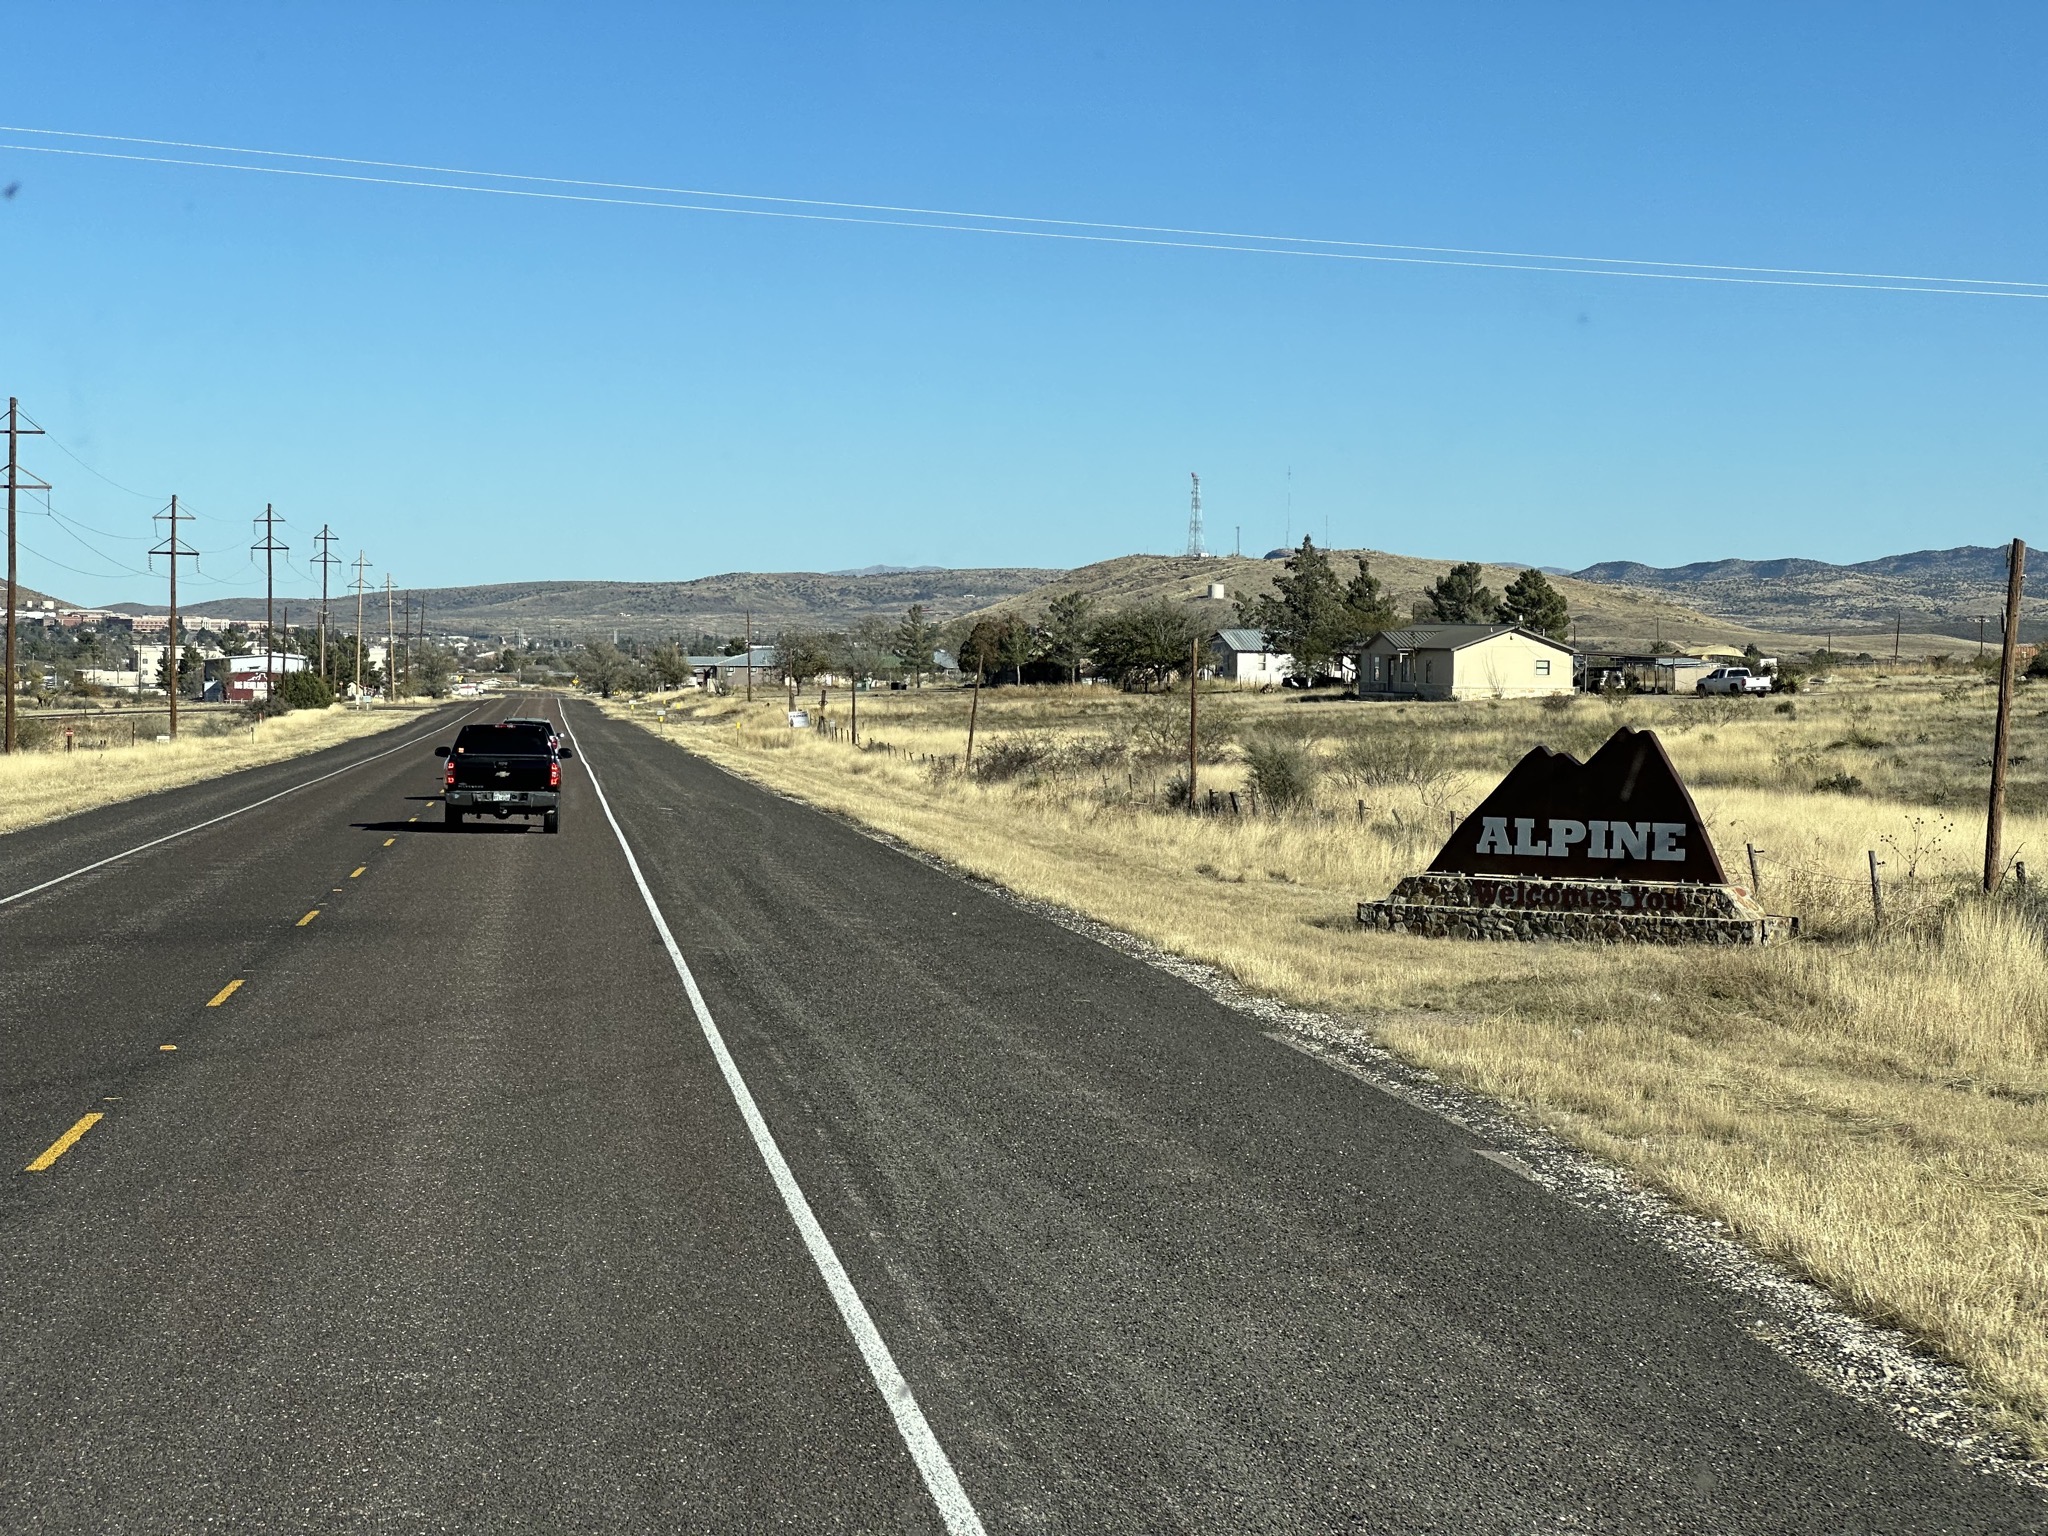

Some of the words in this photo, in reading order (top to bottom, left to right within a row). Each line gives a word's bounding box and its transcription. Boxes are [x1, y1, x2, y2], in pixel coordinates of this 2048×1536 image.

[1476, 816, 1687, 862] ALPINE
[1473, 880, 1622, 908] Welcomes
[1631, 886, 1686, 912] You
